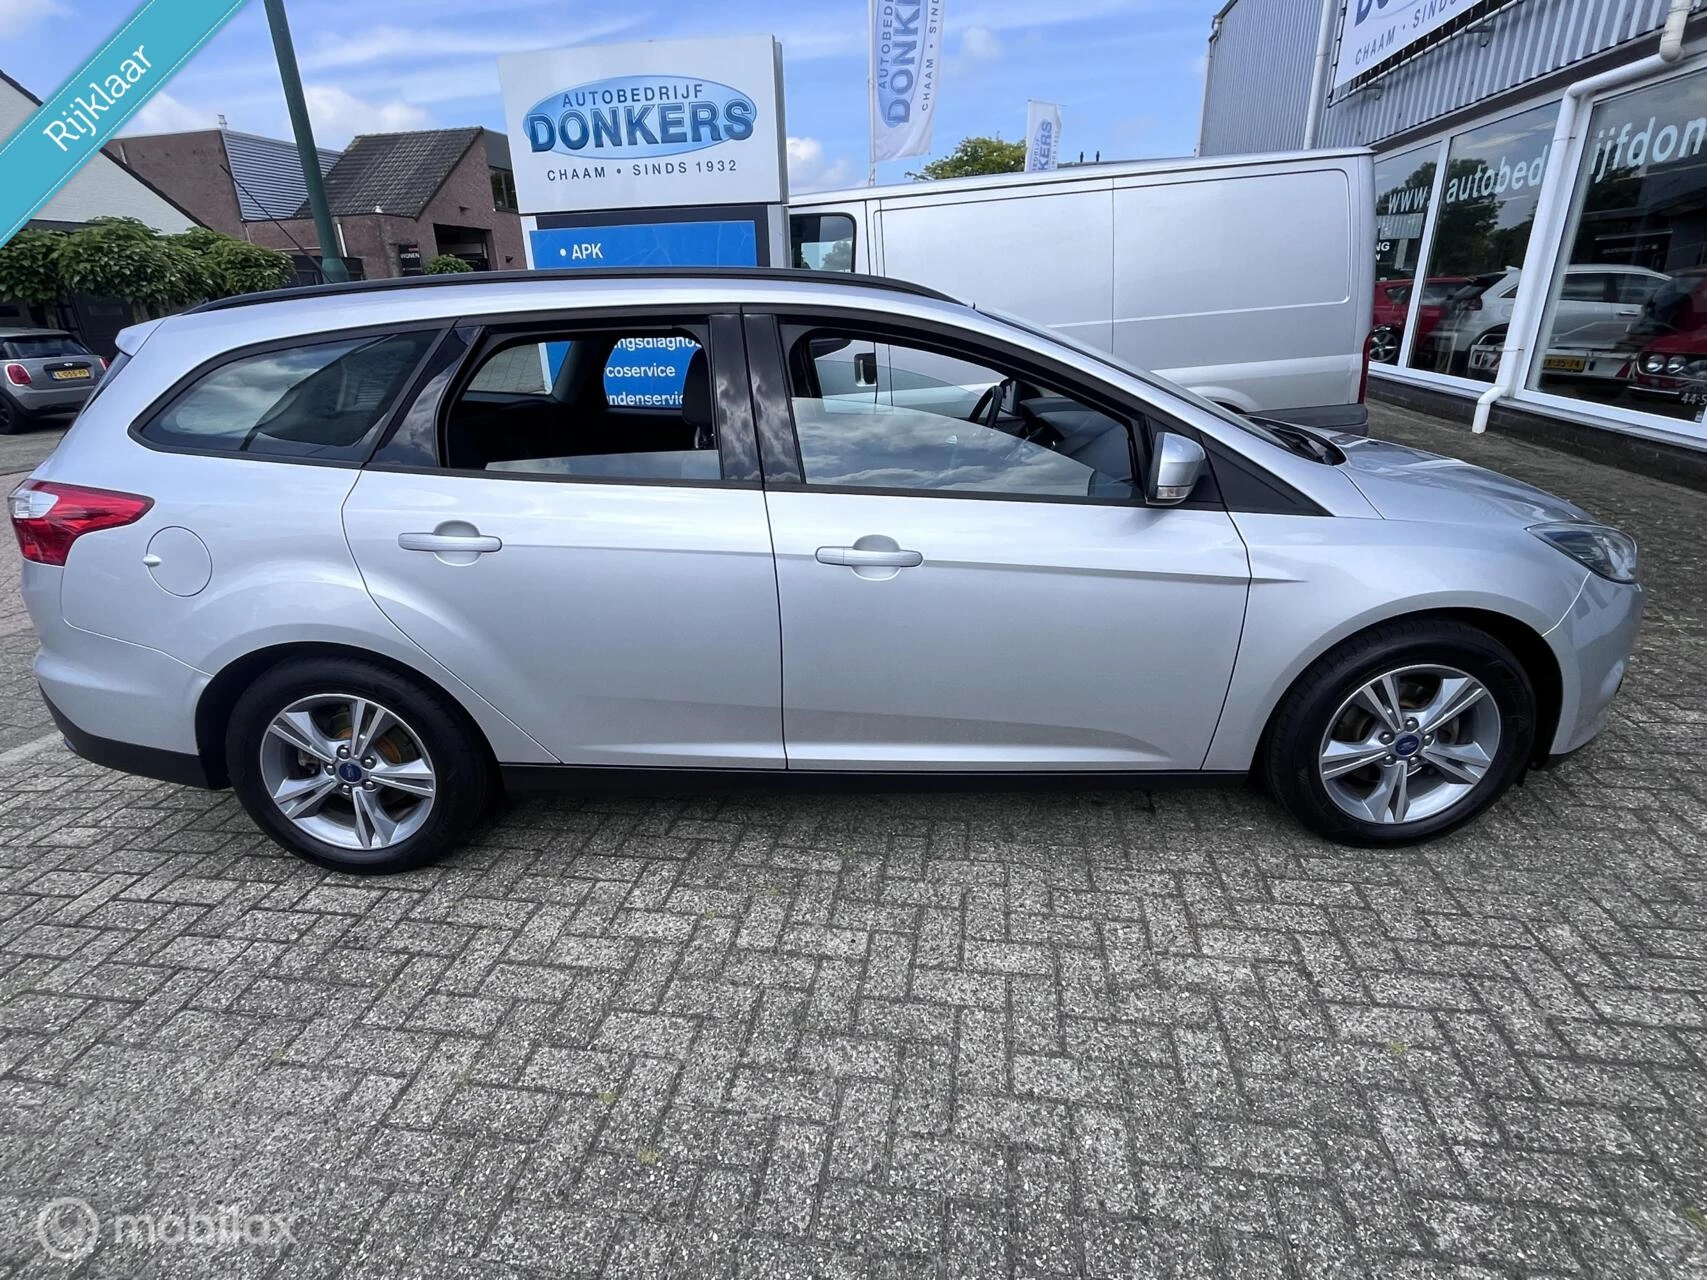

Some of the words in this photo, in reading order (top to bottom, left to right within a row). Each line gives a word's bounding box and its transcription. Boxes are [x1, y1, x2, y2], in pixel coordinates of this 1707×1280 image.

[879, 0, 894, 90] AUTOBED
[1355, 27, 1397, 66] CHAAM
[562, 84, 704, 108] AUTOBEDRIJF
[921, 58, 935, 112] CHAAM
[527, 98, 754, 153] DONKERS
[547, 166, 606, 182] CHAAM
[633, 161, 688, 177] SINDS
[695, 159, 738, 174] 1932
[1446, 144, 1549, 204] autobed
[571, 242, 604, 260] APK
[613, 336, 702, 351] ngsdiagno
[605, 363, 676, 377] coservice
[607, 391, 684, 405] ndenservi
